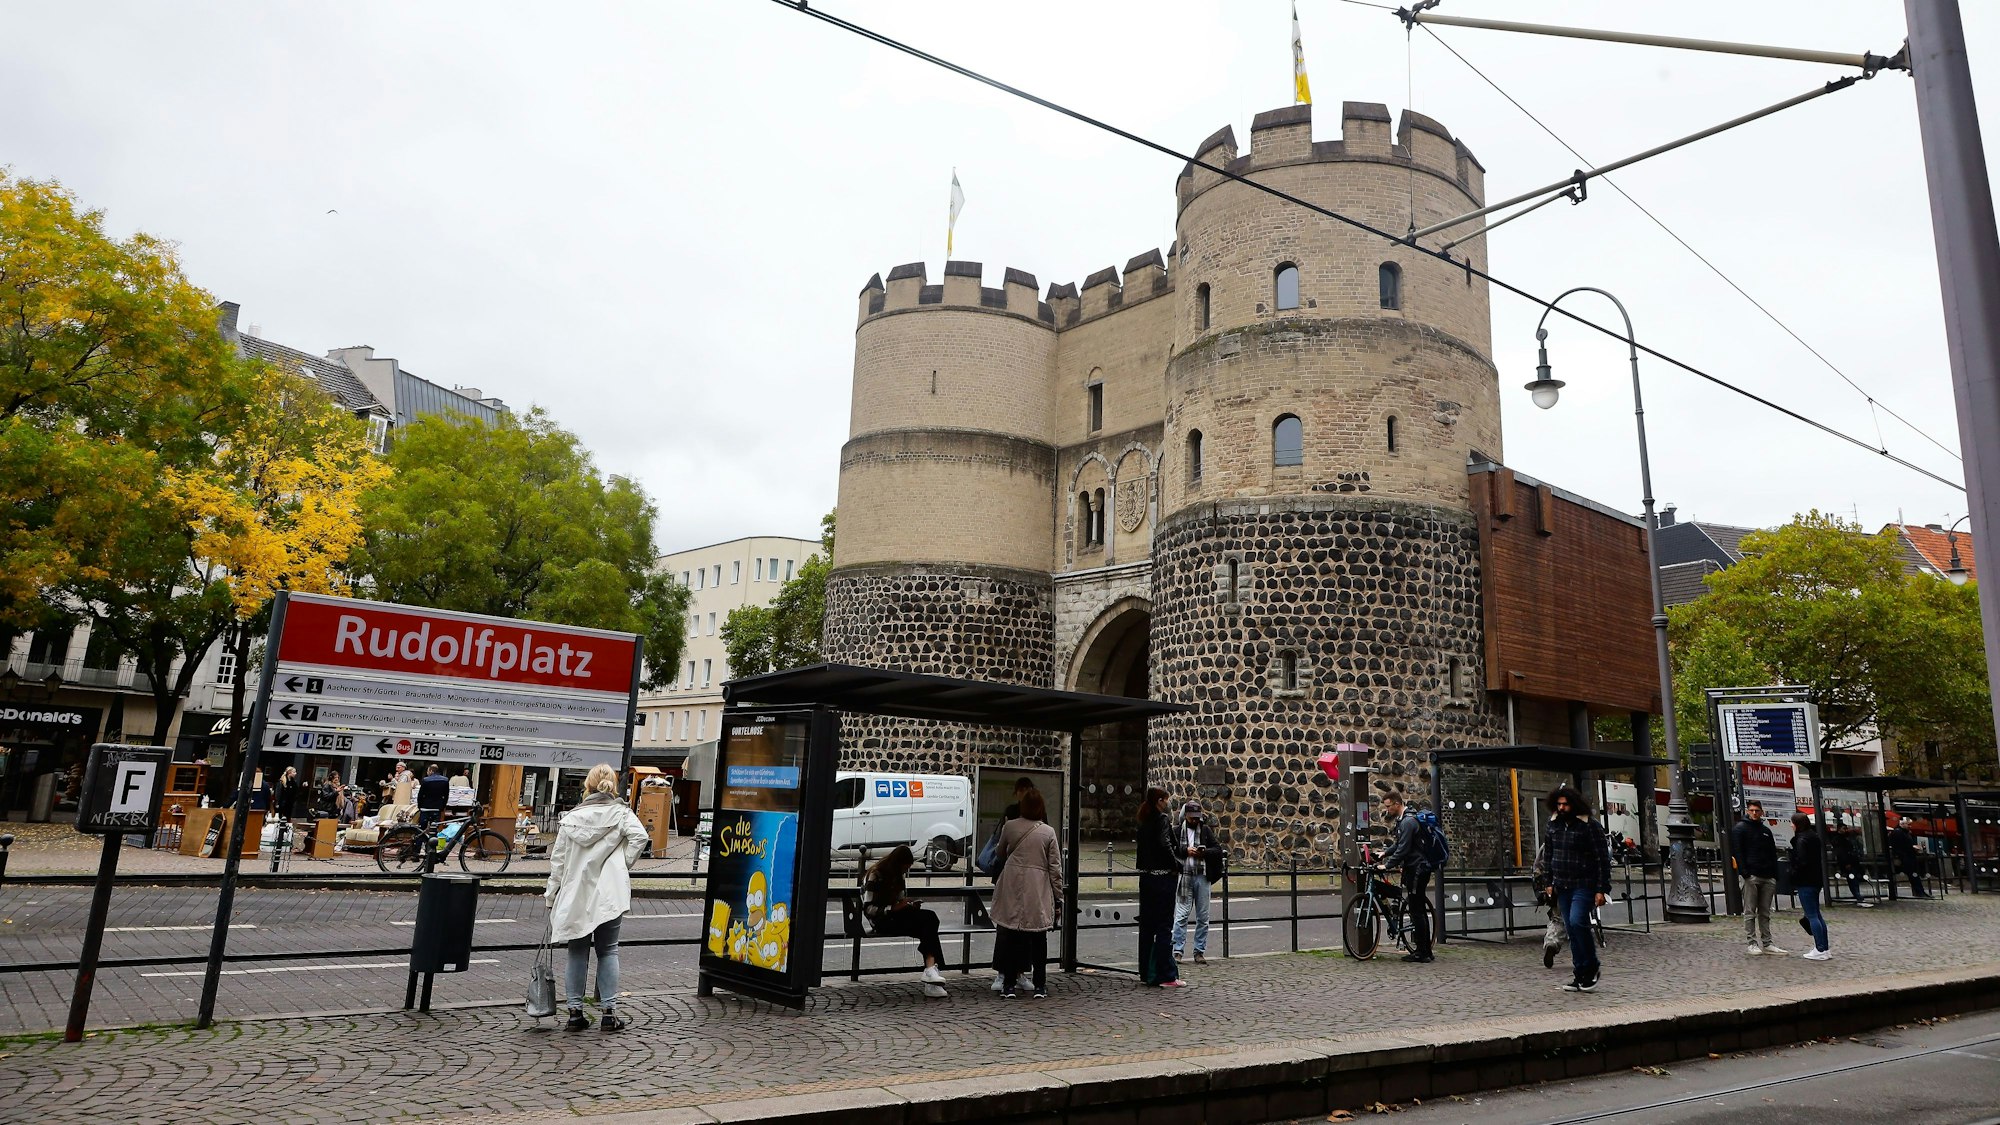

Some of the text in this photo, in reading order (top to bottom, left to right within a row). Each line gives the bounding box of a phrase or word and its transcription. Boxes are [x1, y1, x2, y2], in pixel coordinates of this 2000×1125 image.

[334, 614, 593, 678] Rudolfplatz
[310, 680, 318, 692] 1
[327, 683, 361, 693] Aachener
[363, 687, 399, 696] Str./Gürtel
[405, 690, 442, 700] Braunsfeld
[447, 694, 490, 704] Müngersdorf
[494, 698, 562, 710] RheinEnergieSTADION
[567, 704, 590, 712] Weiden
[306, 708, 314, 718] 7
[322, 710, 356, 720] Aachener
[358, 714, 396, 723] Str./Gürtel
[401, 717, 438, 726] Lindenthal
[443, 720, 474, 729] Marsdorf
[297, 733, 314, 748] U
[317, 736, 333, 748] 12
[336, 738, 353, 749] 15
[397, 743, 411, 751] Bus
[414, 742, 438, 755] 136
[441, 746, 475, 755] Hohenlind
[480, 746, 504, 759] 146
[506, 750, 537, 759] Deckstein
[120, 770, 147, 805] F
[1747, 765, 1787, 786] Rudolfplatz
[735, 815, 752, 836] die
